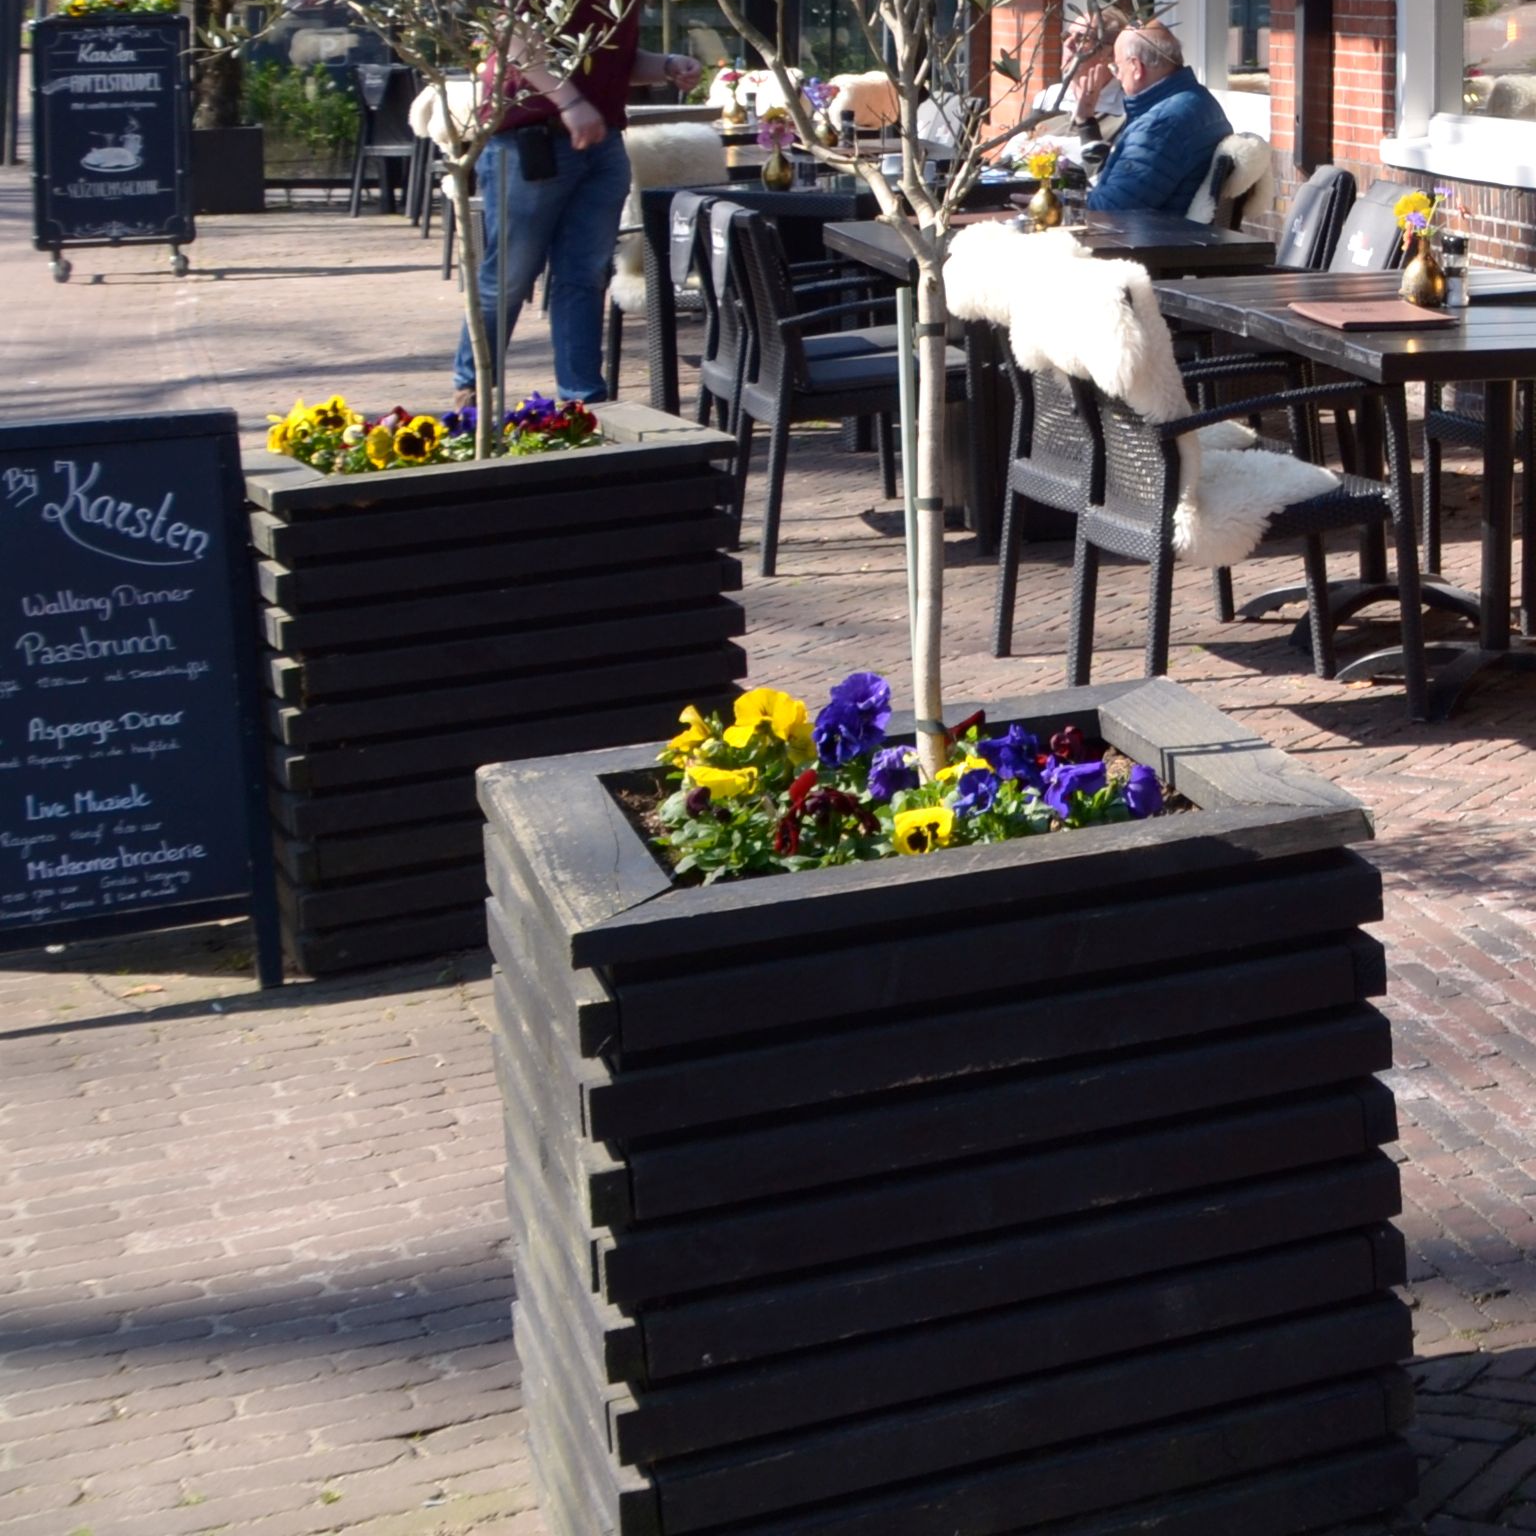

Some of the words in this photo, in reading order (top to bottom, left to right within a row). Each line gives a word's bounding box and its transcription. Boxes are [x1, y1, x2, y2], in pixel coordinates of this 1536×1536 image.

[42, 460, 210, 565] Karsten
[112, 584, 195, 607] Dinner
[15, 617, 177, 667] Paasbrunch
[29, 716, 119, 751] Asperge
[119, 710, 185, 731] Diner
[25, 794, 70, 820] Live
[74, 782, 153, 814] Muziek
